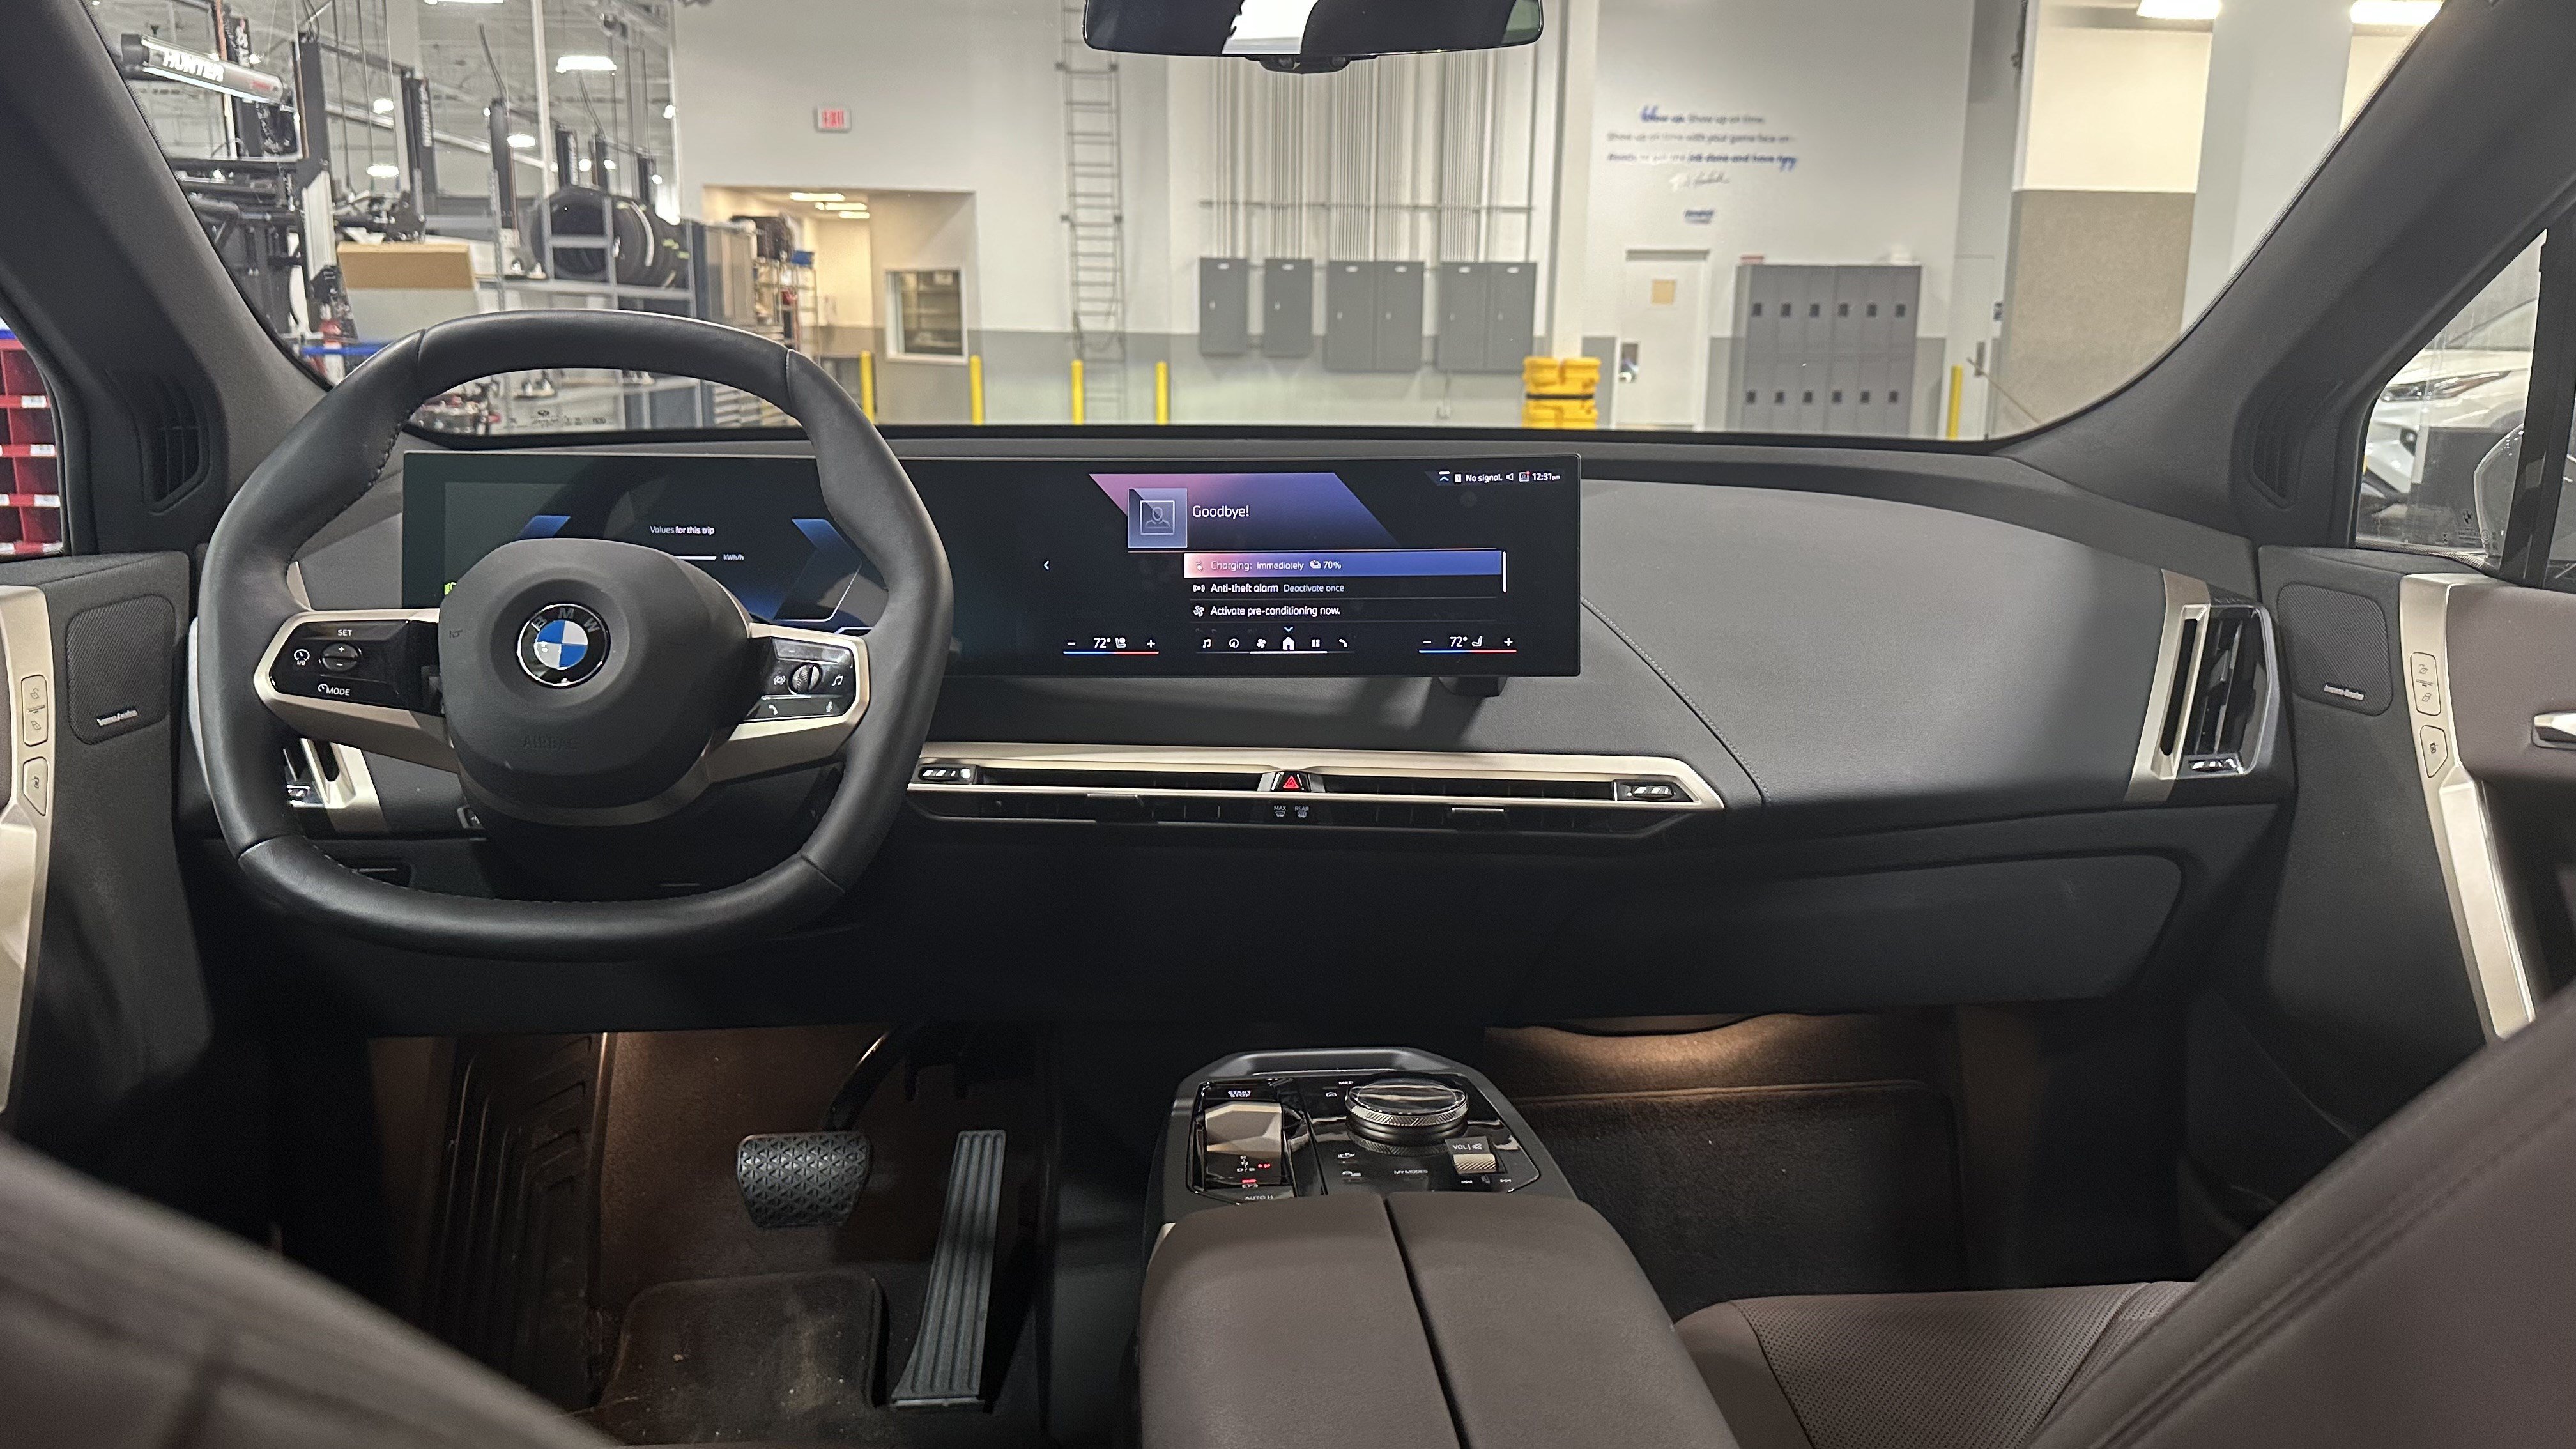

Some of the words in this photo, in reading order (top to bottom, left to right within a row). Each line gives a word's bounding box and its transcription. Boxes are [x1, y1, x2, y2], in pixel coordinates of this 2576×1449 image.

[163, 50, 224, 82] HUNTER
[1478, 473, 1503, 484] signal.
[1192, 505, 1250, 519] Goodbye!
[650, 526, 675, 534] Values
[675, 526, 686, 534] for
[687, 526, 702, 534] this
[702, 526, 715, 535] trip
[1211, 560, 1252, 571] Charging:
[1257, 562, 1305, 571] Immediately
[1323, 560, 1342, 569] 70%
[1210, 583, 1252, 593] Anti-theft
[1254, 583, 1279, 593] alarm
[1284, 584, 1324, 592] Deactivate
[1210, 606, 1246, 616] Activate
[1247, 606, 1317, 617] pre-conditioning
[326, 687, 351, 696] MODE
